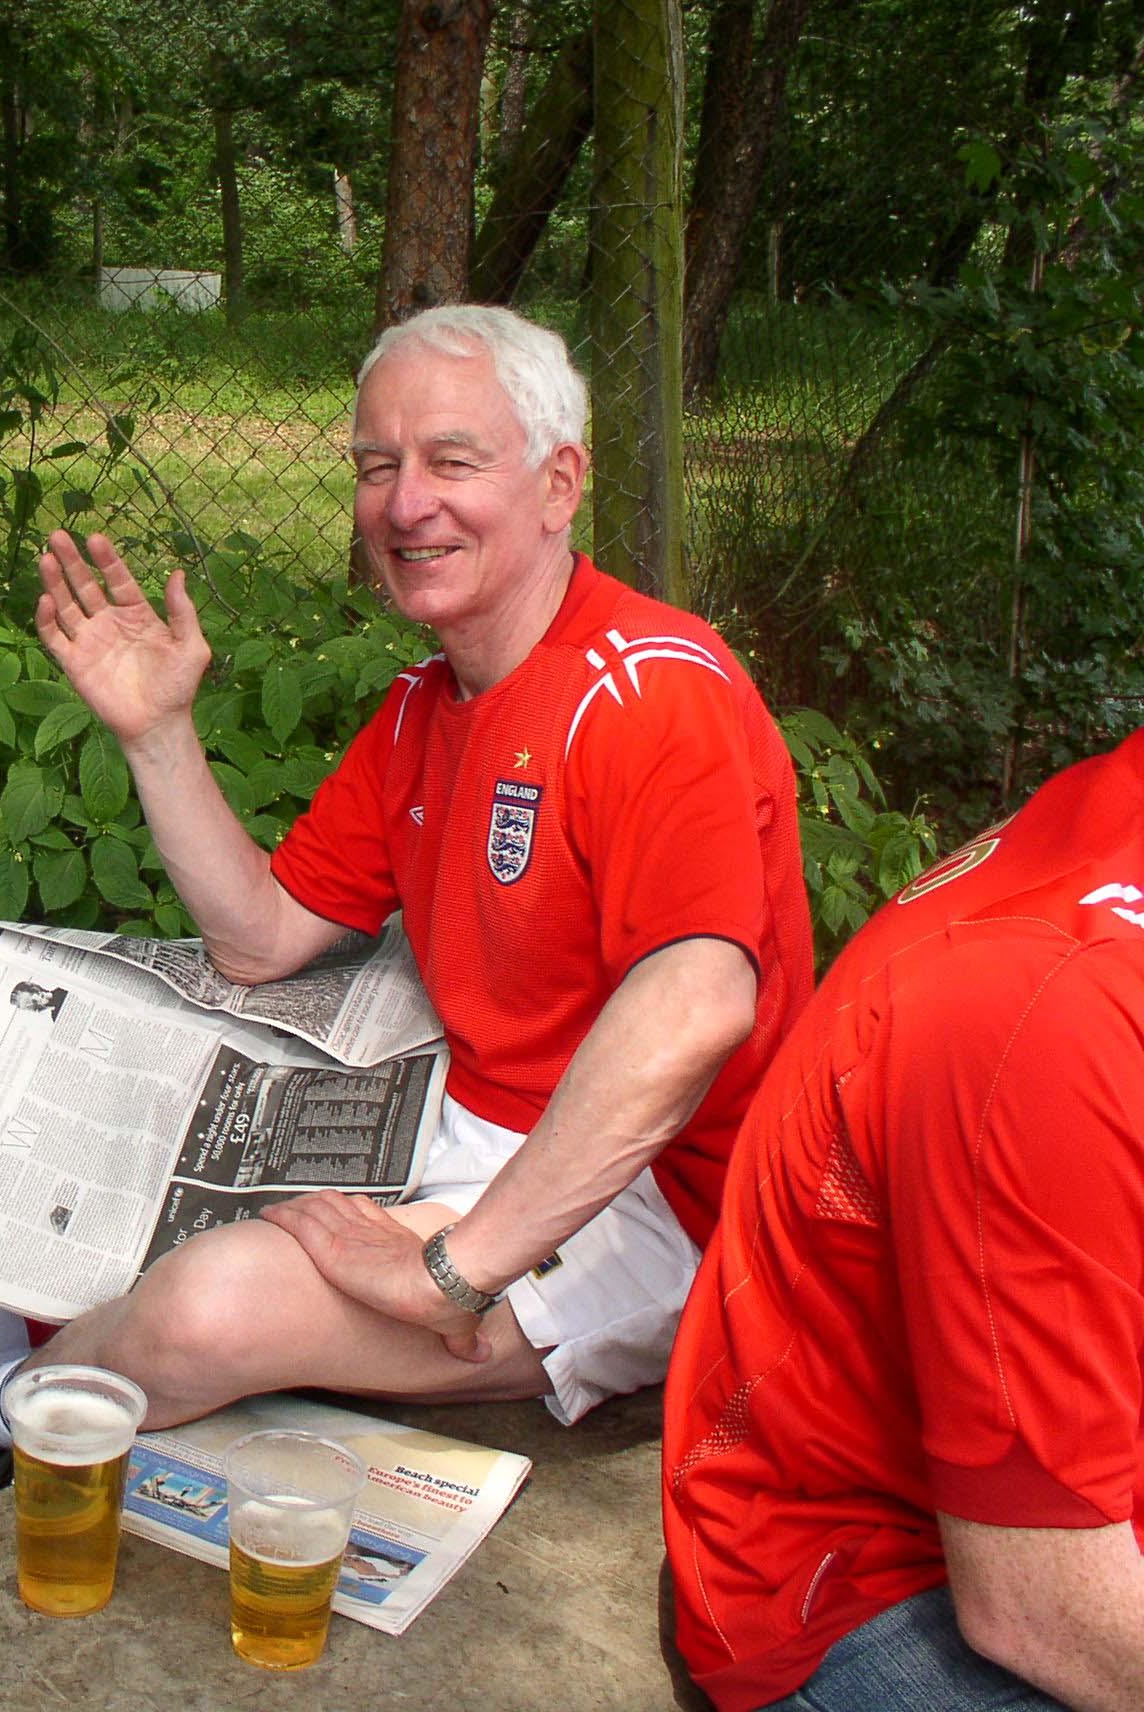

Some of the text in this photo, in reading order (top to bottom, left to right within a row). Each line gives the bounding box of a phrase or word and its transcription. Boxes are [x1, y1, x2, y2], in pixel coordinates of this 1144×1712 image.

[495, 782, 539, 801] ENGLAND
[220, 1082, 233, 1101] four
[235, 1081, 246, 1099] only
[214, 1101, 226, 1123] under
[228, 1099, 239, 1111] for
[205, 1122, 219, 1144] night
[221, 1111, 236, 1135] rooms
[230, 1113, 250, 1144] £49
[203, 1141, 212, 1150] a
[193, 1147, 208, 1172] Spend
[193, 1208, 214, 1230] Day
[367, 1466, 473, 1506] Europe's finest to
[394, 1465, 481, 1497] Beach special
[422, 1494, 468, 1513] beauty
